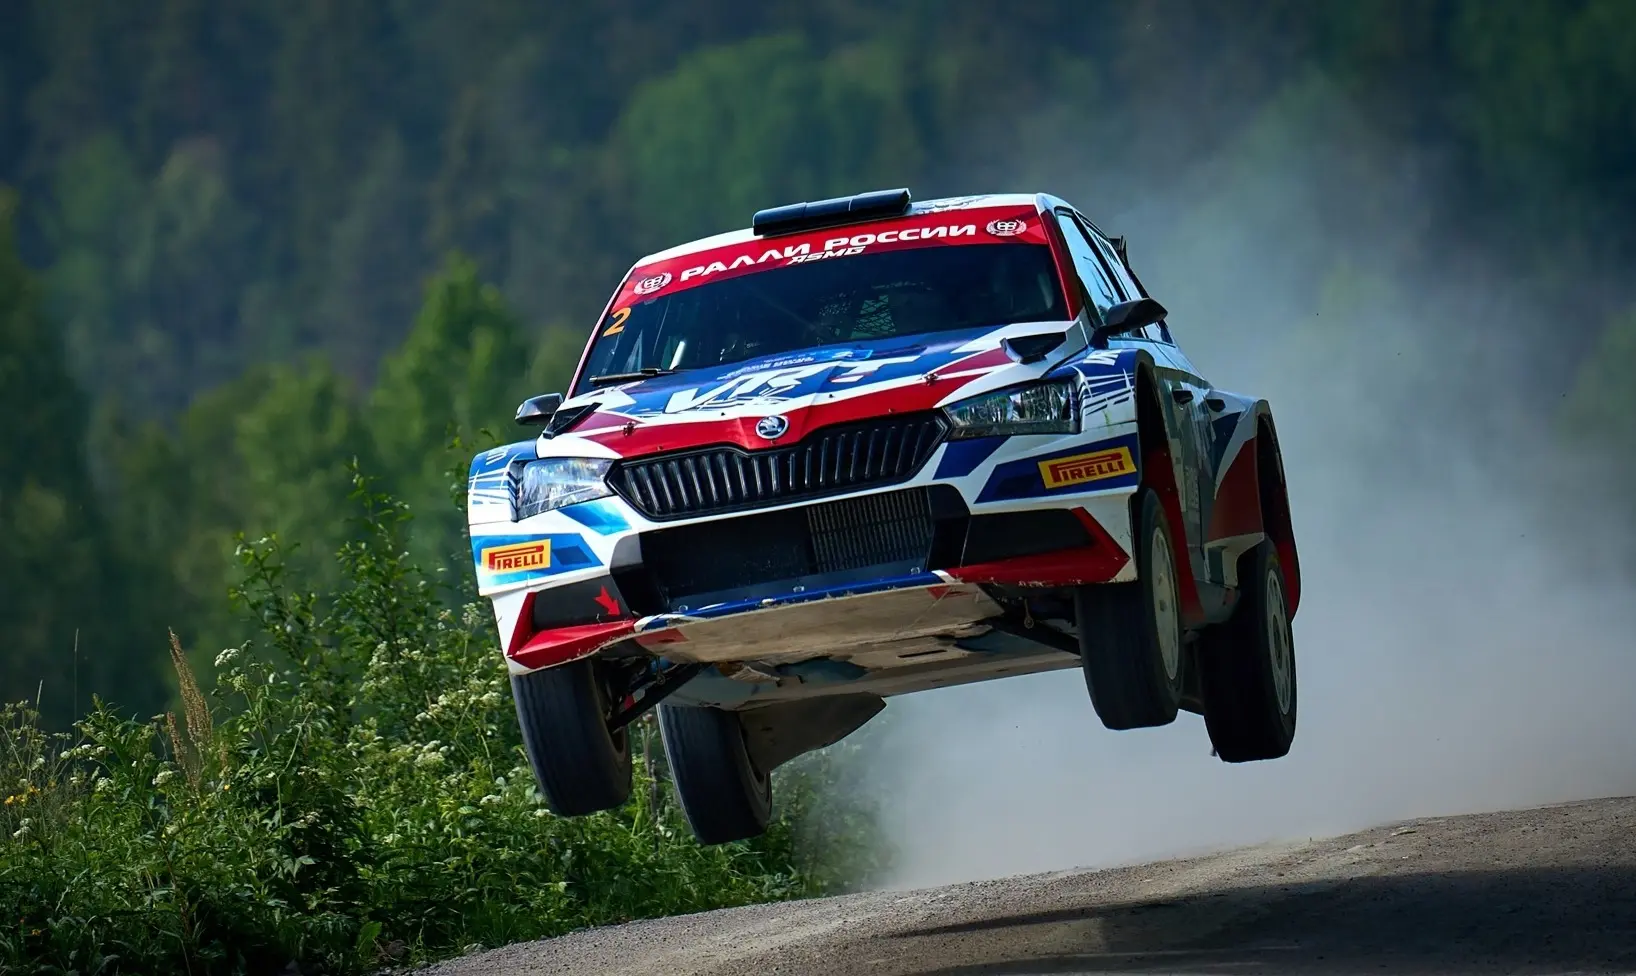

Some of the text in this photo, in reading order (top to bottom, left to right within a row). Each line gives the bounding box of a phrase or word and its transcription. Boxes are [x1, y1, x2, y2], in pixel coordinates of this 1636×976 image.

[680, 224, 976, 282] РАЛЛИ РОССИИ
[602, 307, 631, 337] 2
[1048, 452, 1125, 483] PIRELLI
[488, 545, 544, 570] PIRELLI
